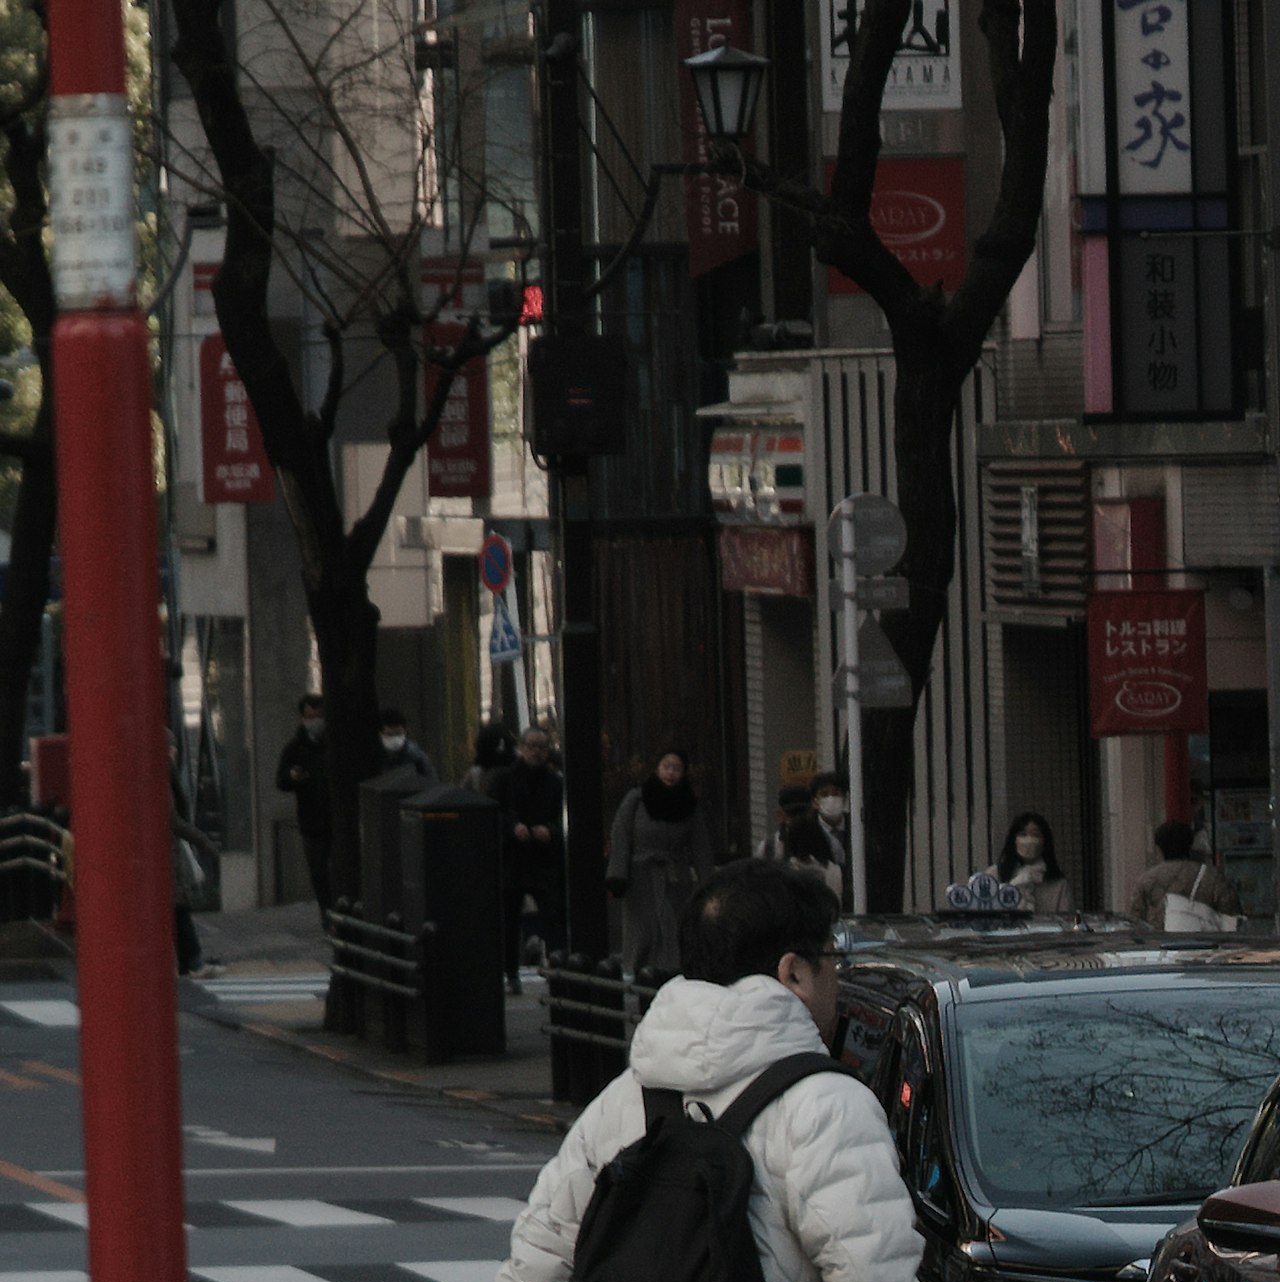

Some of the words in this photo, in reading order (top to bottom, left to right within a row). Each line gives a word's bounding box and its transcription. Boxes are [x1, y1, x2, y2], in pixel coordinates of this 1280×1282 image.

[1146, 253, 1178, 392] 和装小物
[1105, 618, 1188, 637] トルコ料理
[1105, 639, 1189, 657] レストラン
